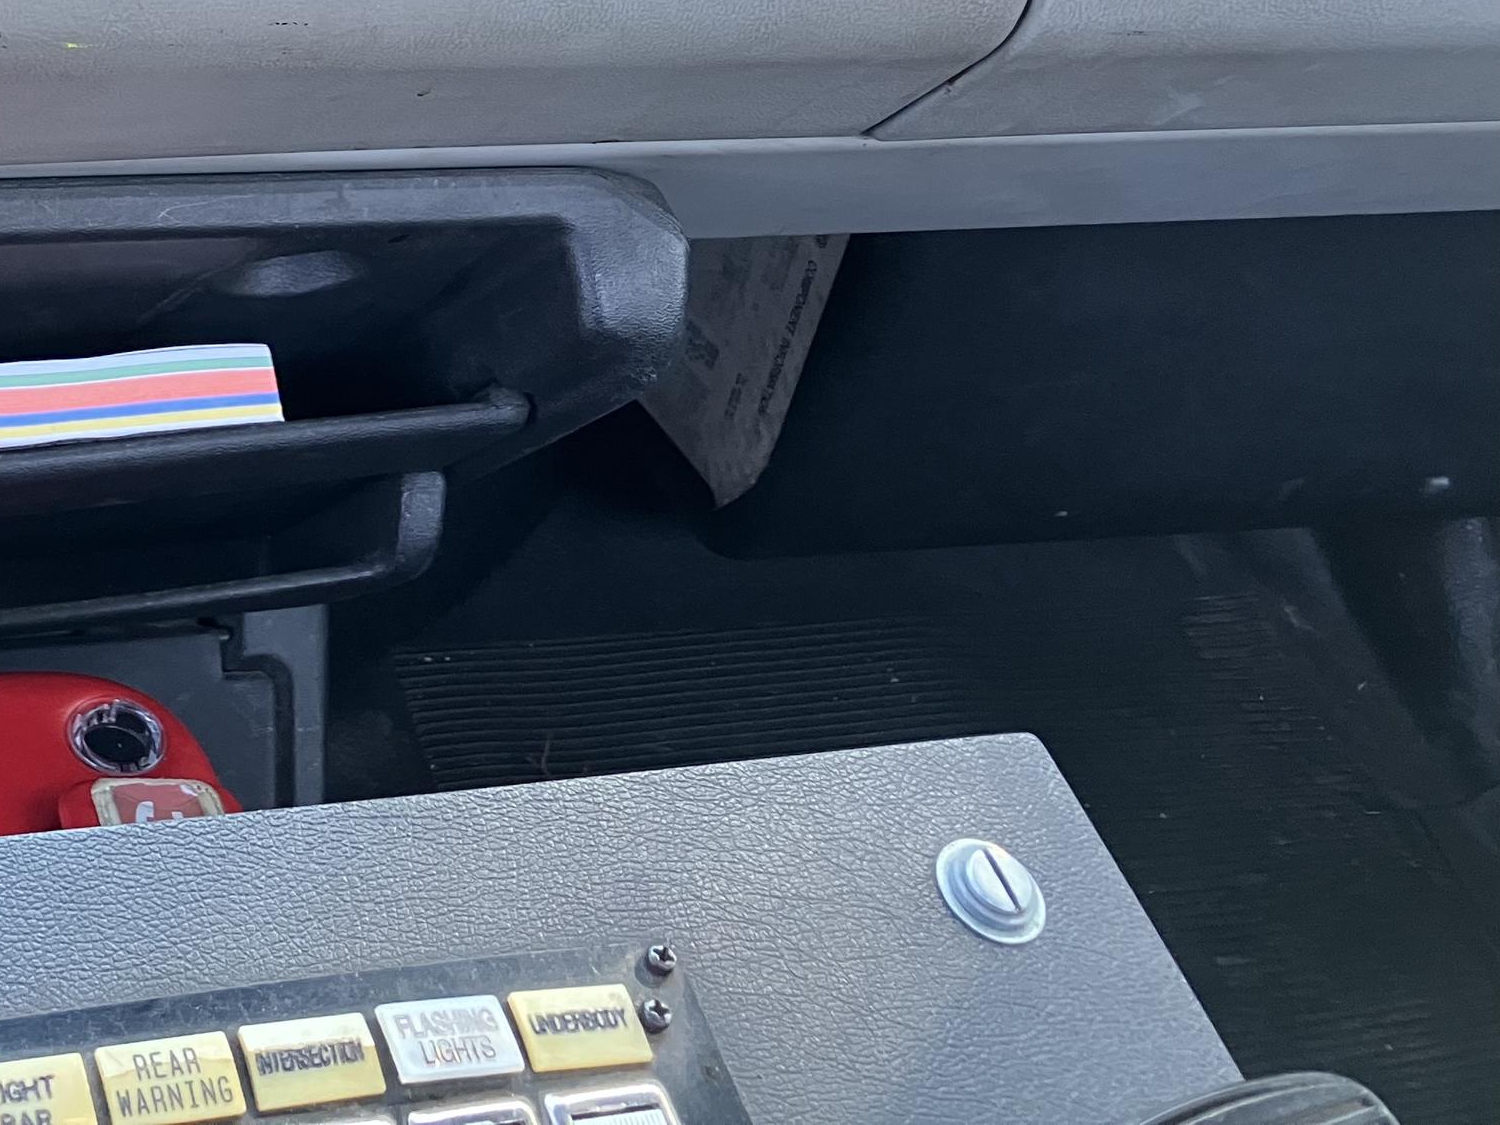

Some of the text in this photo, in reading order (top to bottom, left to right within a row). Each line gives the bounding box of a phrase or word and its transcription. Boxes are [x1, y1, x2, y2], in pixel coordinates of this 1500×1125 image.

[394, 1005, 499, 1039] FLASHING
[528, 1006, 628, 1036] UNDERBODY
[132, 1047, 201, 1081] REAR
[255, 1038, 365, 1076] INTERSECTION
[419, 1034, 496, 1068] LIGHTS
[117, 1075, 233, 1117] WARNING
